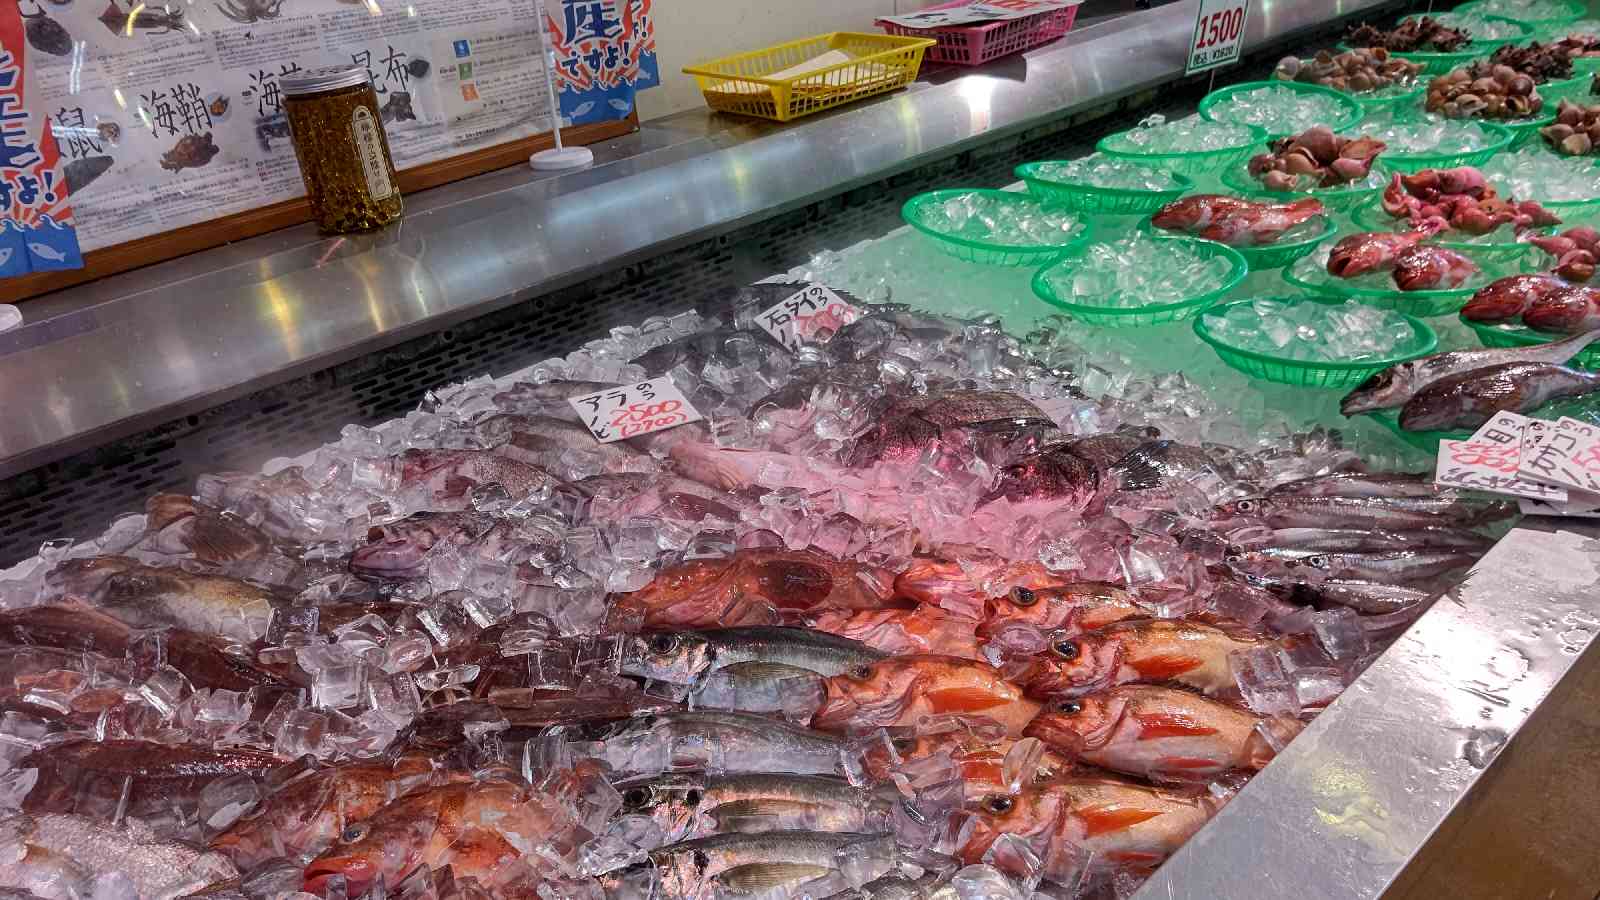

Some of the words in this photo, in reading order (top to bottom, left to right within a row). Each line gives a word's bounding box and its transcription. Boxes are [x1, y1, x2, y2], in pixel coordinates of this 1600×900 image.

[1196, 7, 1243, 49] 1500
[561, 42, 630, 77] ですよ!
[139, 82, 214, 138] 海鞘
[578, 391, 627, 413] アラ
